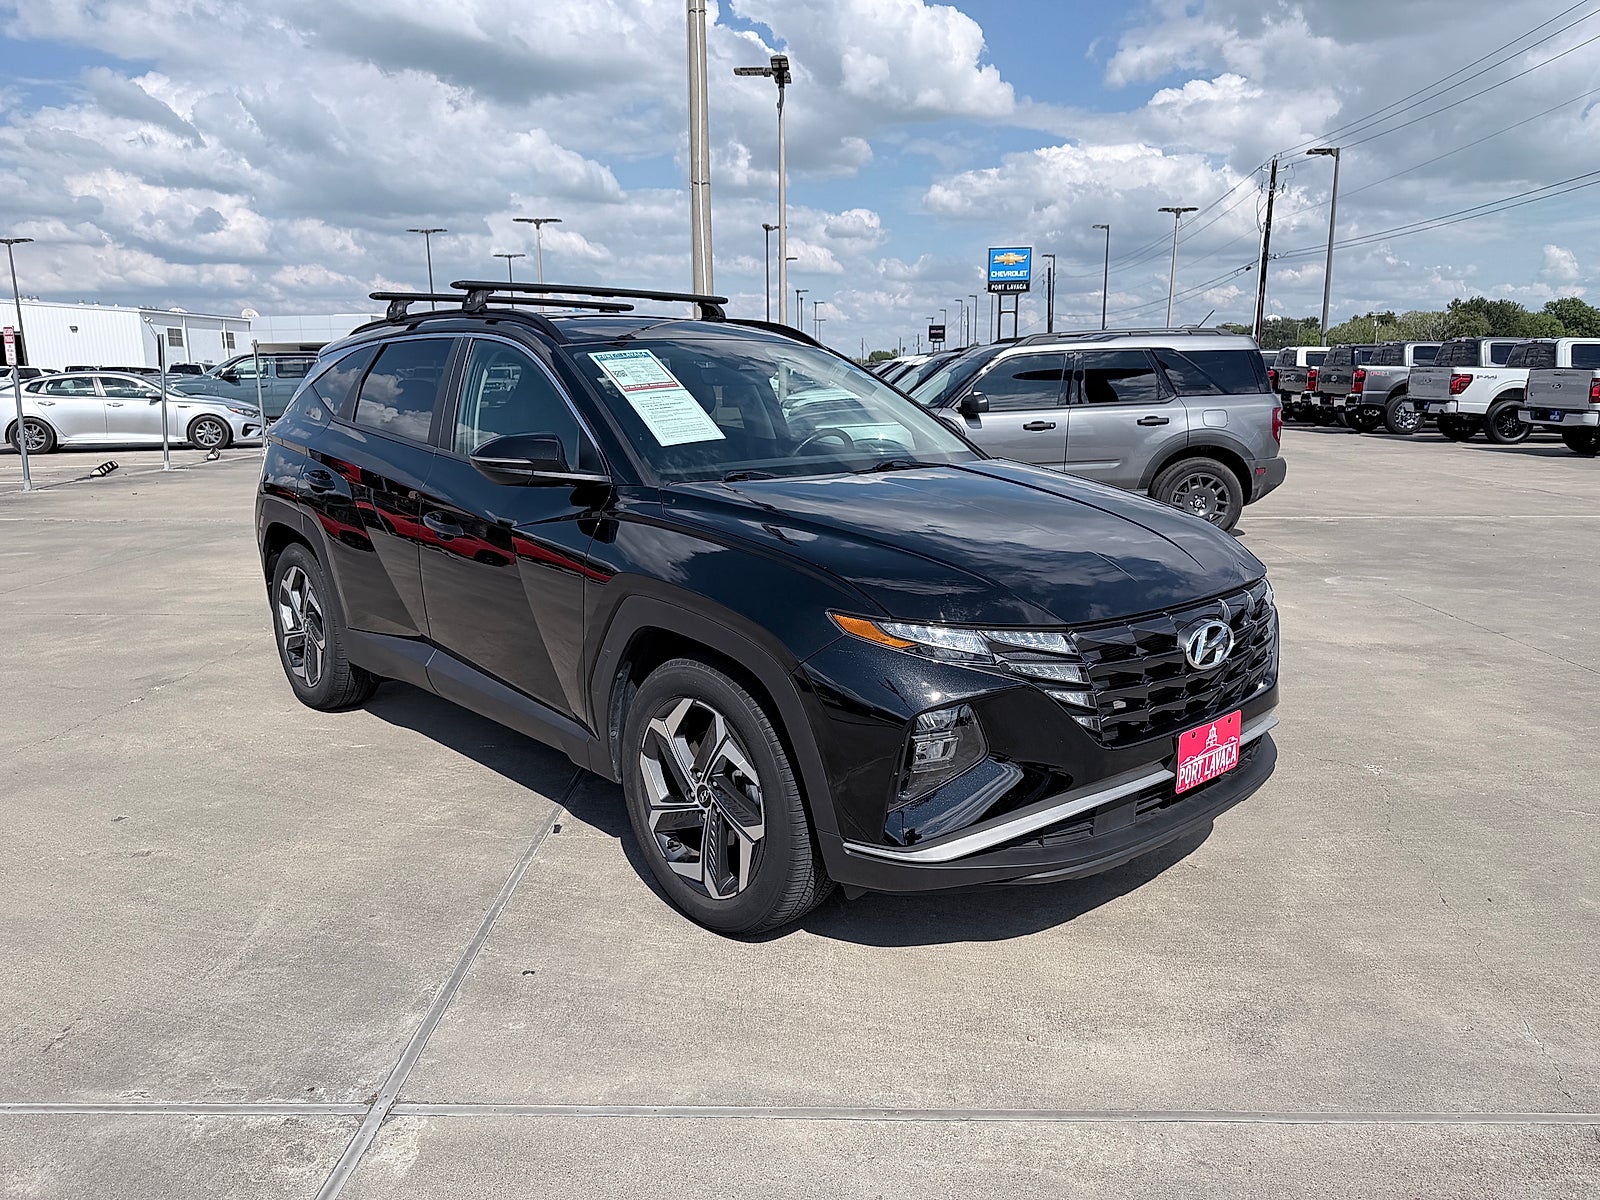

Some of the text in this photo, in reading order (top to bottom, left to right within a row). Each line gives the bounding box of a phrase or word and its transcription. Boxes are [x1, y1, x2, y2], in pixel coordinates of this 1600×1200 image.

[991, 270, 1028, 278] CHEVROLET
[1178, 744, 1236, 787] PORT LAVACA
